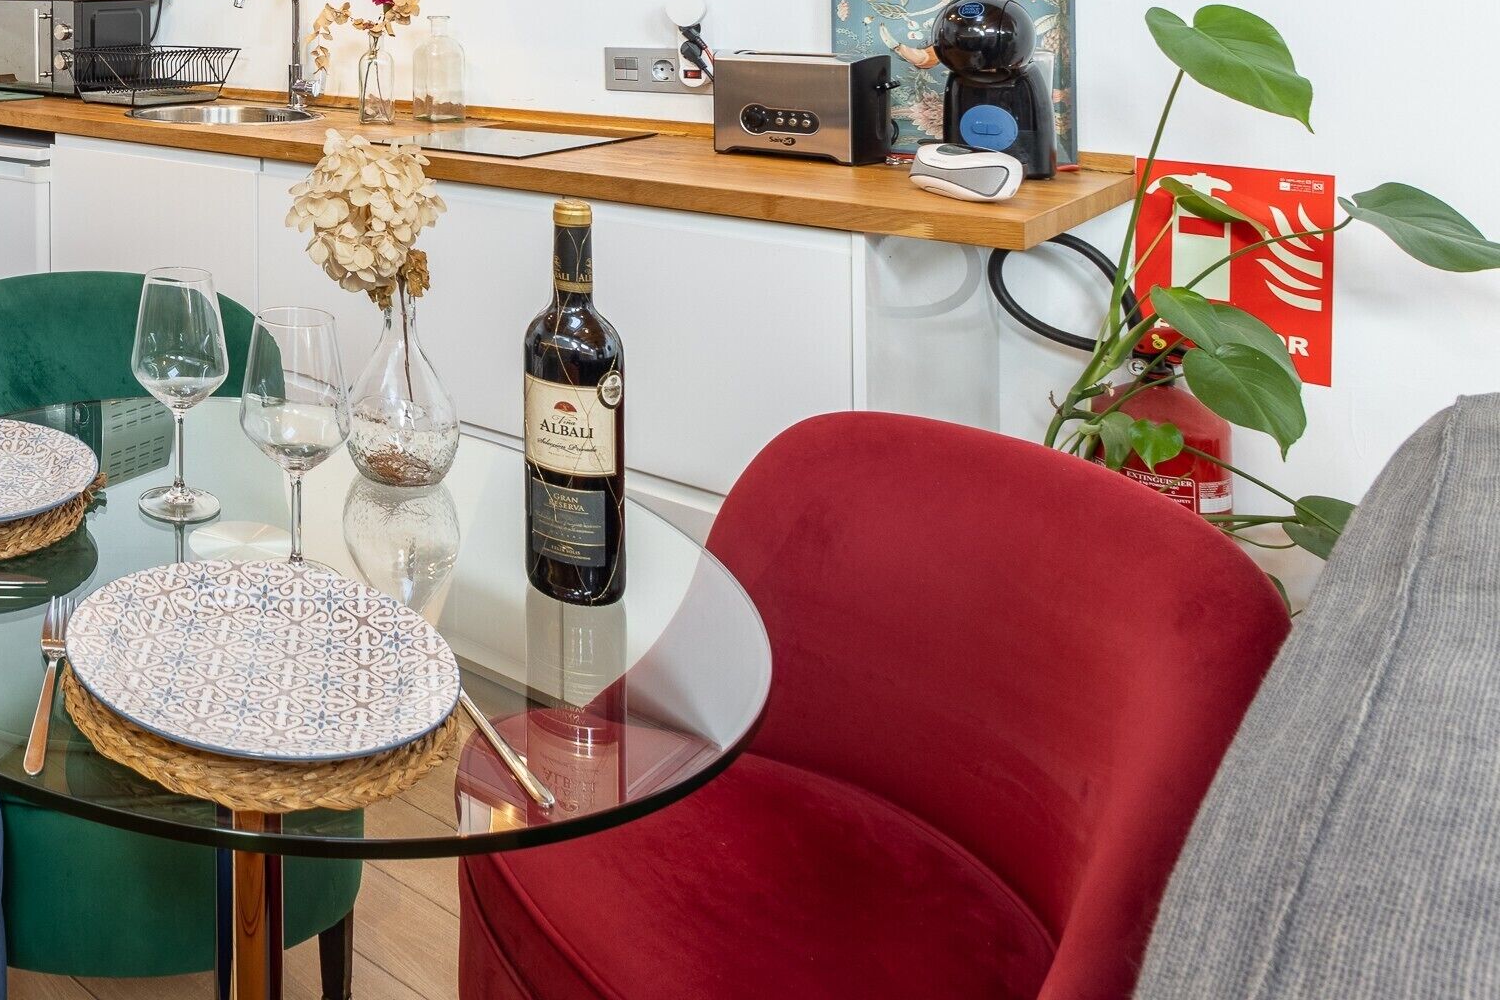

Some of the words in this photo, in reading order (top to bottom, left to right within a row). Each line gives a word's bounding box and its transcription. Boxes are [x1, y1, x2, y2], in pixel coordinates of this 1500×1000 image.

[539, 418, 594, 439] ALBALI
[553, 493, 579, 504] GRAN
[548, 499, 585, 512] RESERVA
